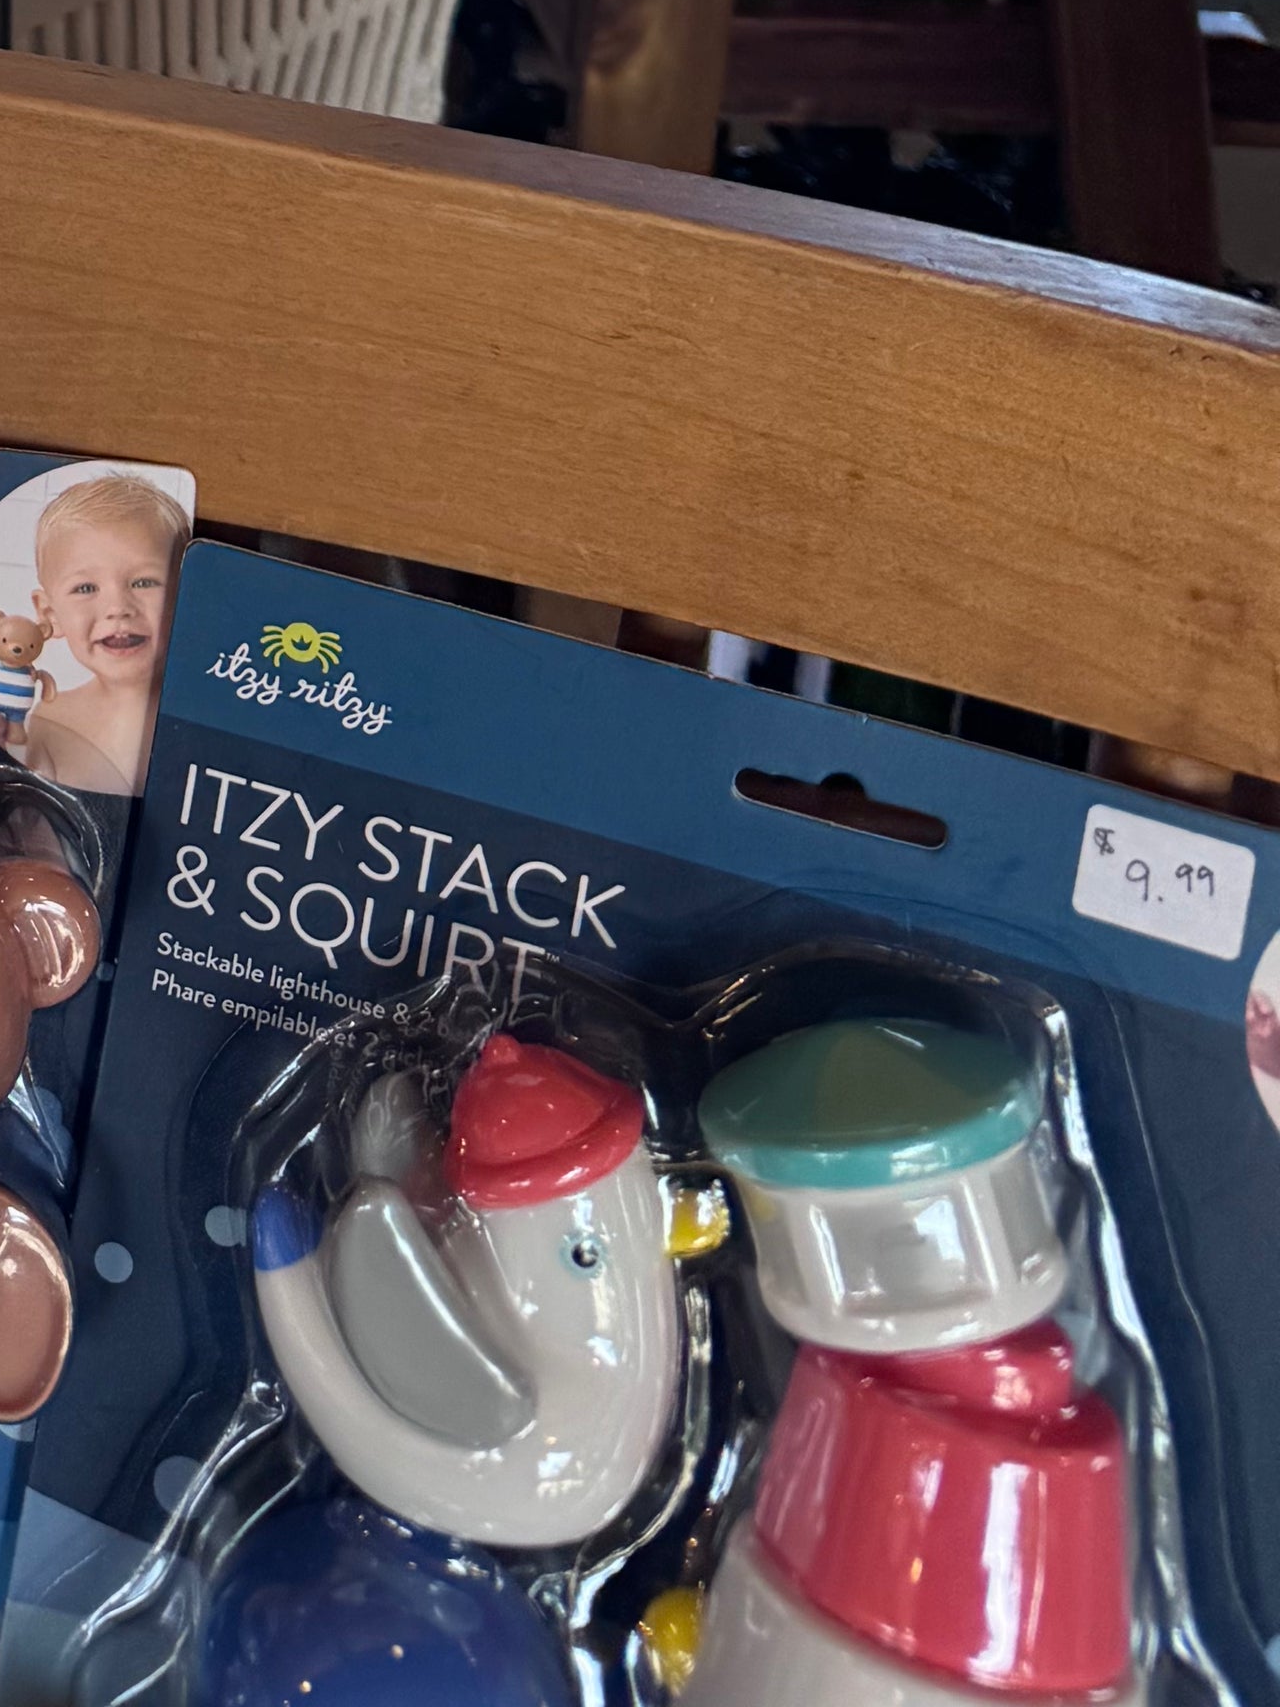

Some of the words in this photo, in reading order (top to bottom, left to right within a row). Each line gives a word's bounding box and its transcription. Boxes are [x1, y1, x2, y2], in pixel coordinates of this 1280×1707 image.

[205, 643, 283, 705] itzy
[289, 671, 393, 735] ritzy
[165, 845, 216, 918] &
[179, 763, 345, 861] ITZY
[357, 815, 627, 949] STACK
[1092, 826, 1216, 903] $9.99
[151, 968, 216, 1008] Phare
[221, 996, 328, 1041] empilable
[156, 932, 265, 983] Stackable
[269, 965, 386, 1020] lighthouse
[392, 1002, 410, 1026] &
